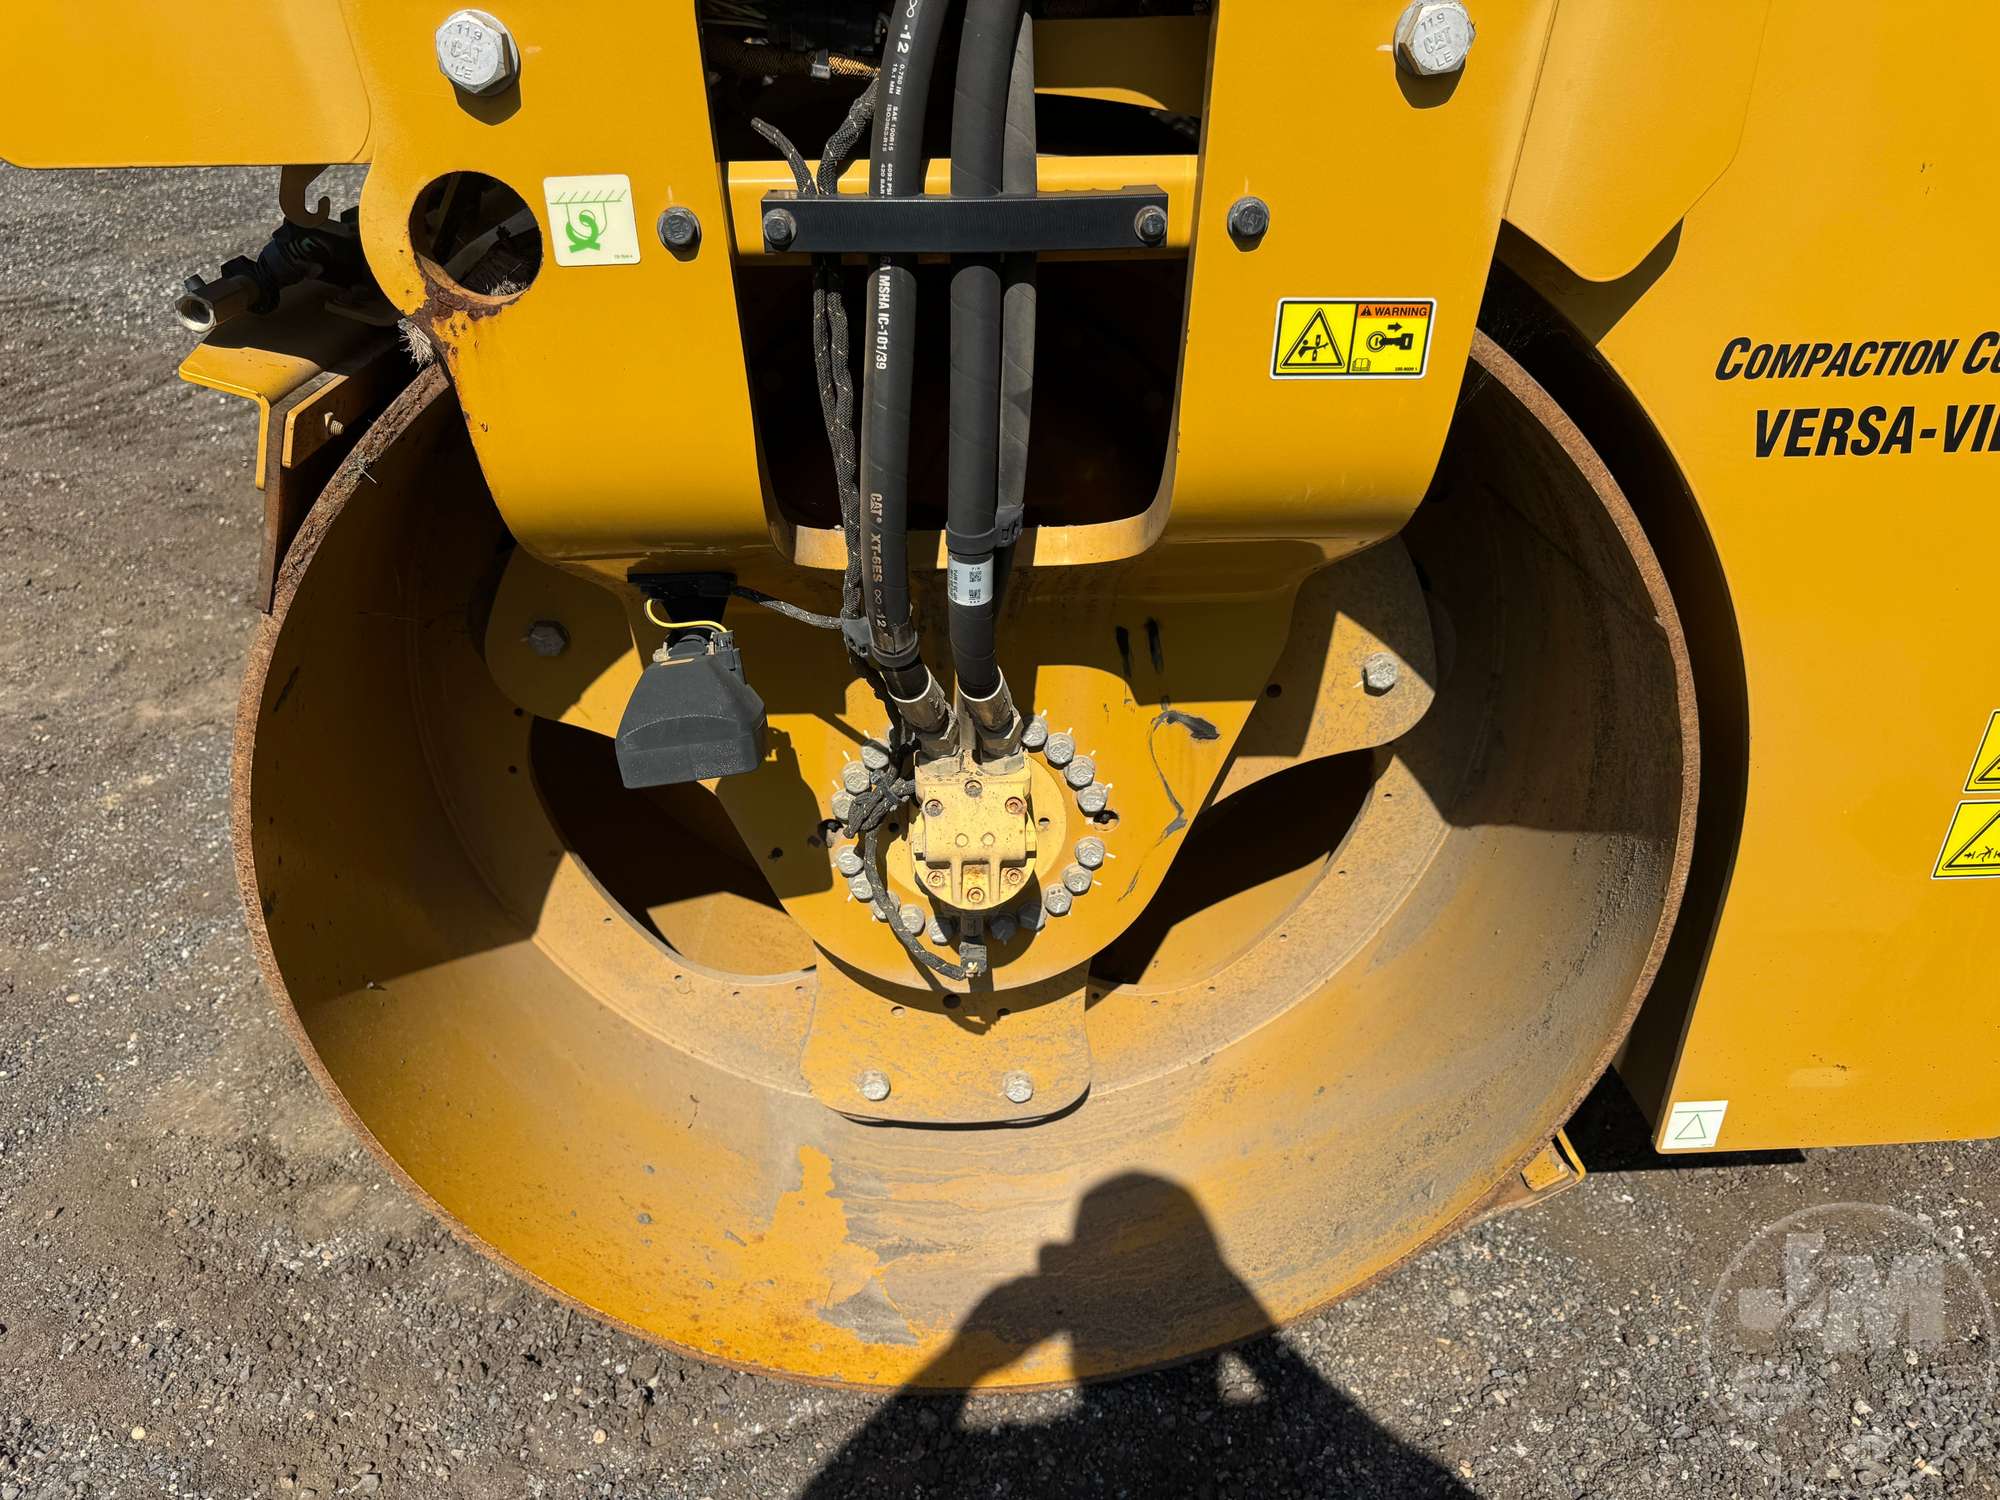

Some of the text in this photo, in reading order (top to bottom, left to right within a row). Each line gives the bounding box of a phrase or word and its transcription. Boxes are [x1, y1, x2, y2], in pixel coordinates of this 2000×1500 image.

[878, 275, 891, 309] MSHA
[1374, 307, 1428, 317] WARNING
[875, 313, 890, 370] IC-101/39
[870, 533, 883, 583] XT-6ES
